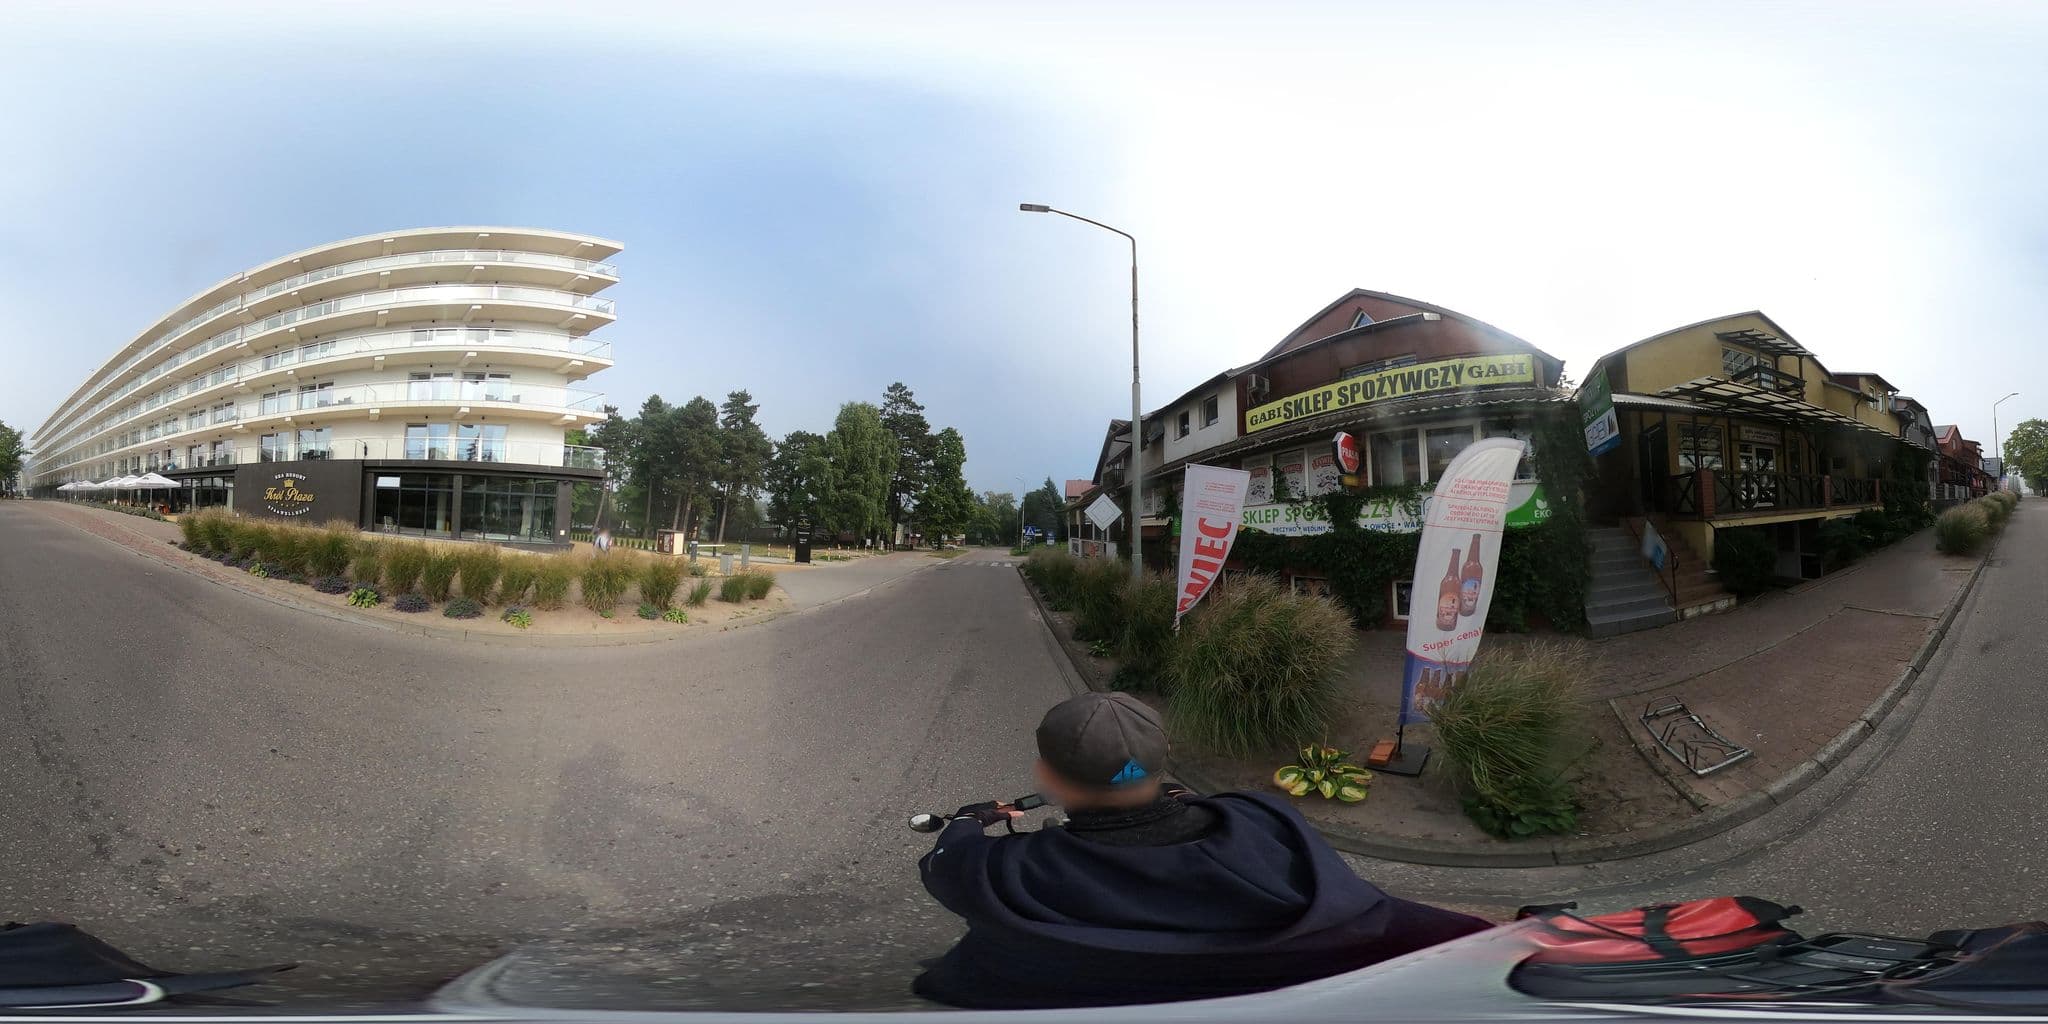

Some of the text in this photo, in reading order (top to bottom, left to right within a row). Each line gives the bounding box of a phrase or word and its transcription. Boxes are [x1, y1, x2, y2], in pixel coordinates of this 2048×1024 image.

[1249, 362, 1526, 427] GABI SKLEP SPOŻYWCZY GABI
[285, 487, 316, 502] Plaza
[1242, 508, 1280, 525] SKLEP
[1534, 510, 1552, 519] EKO
[1422, 639, 1454, 652] Super
